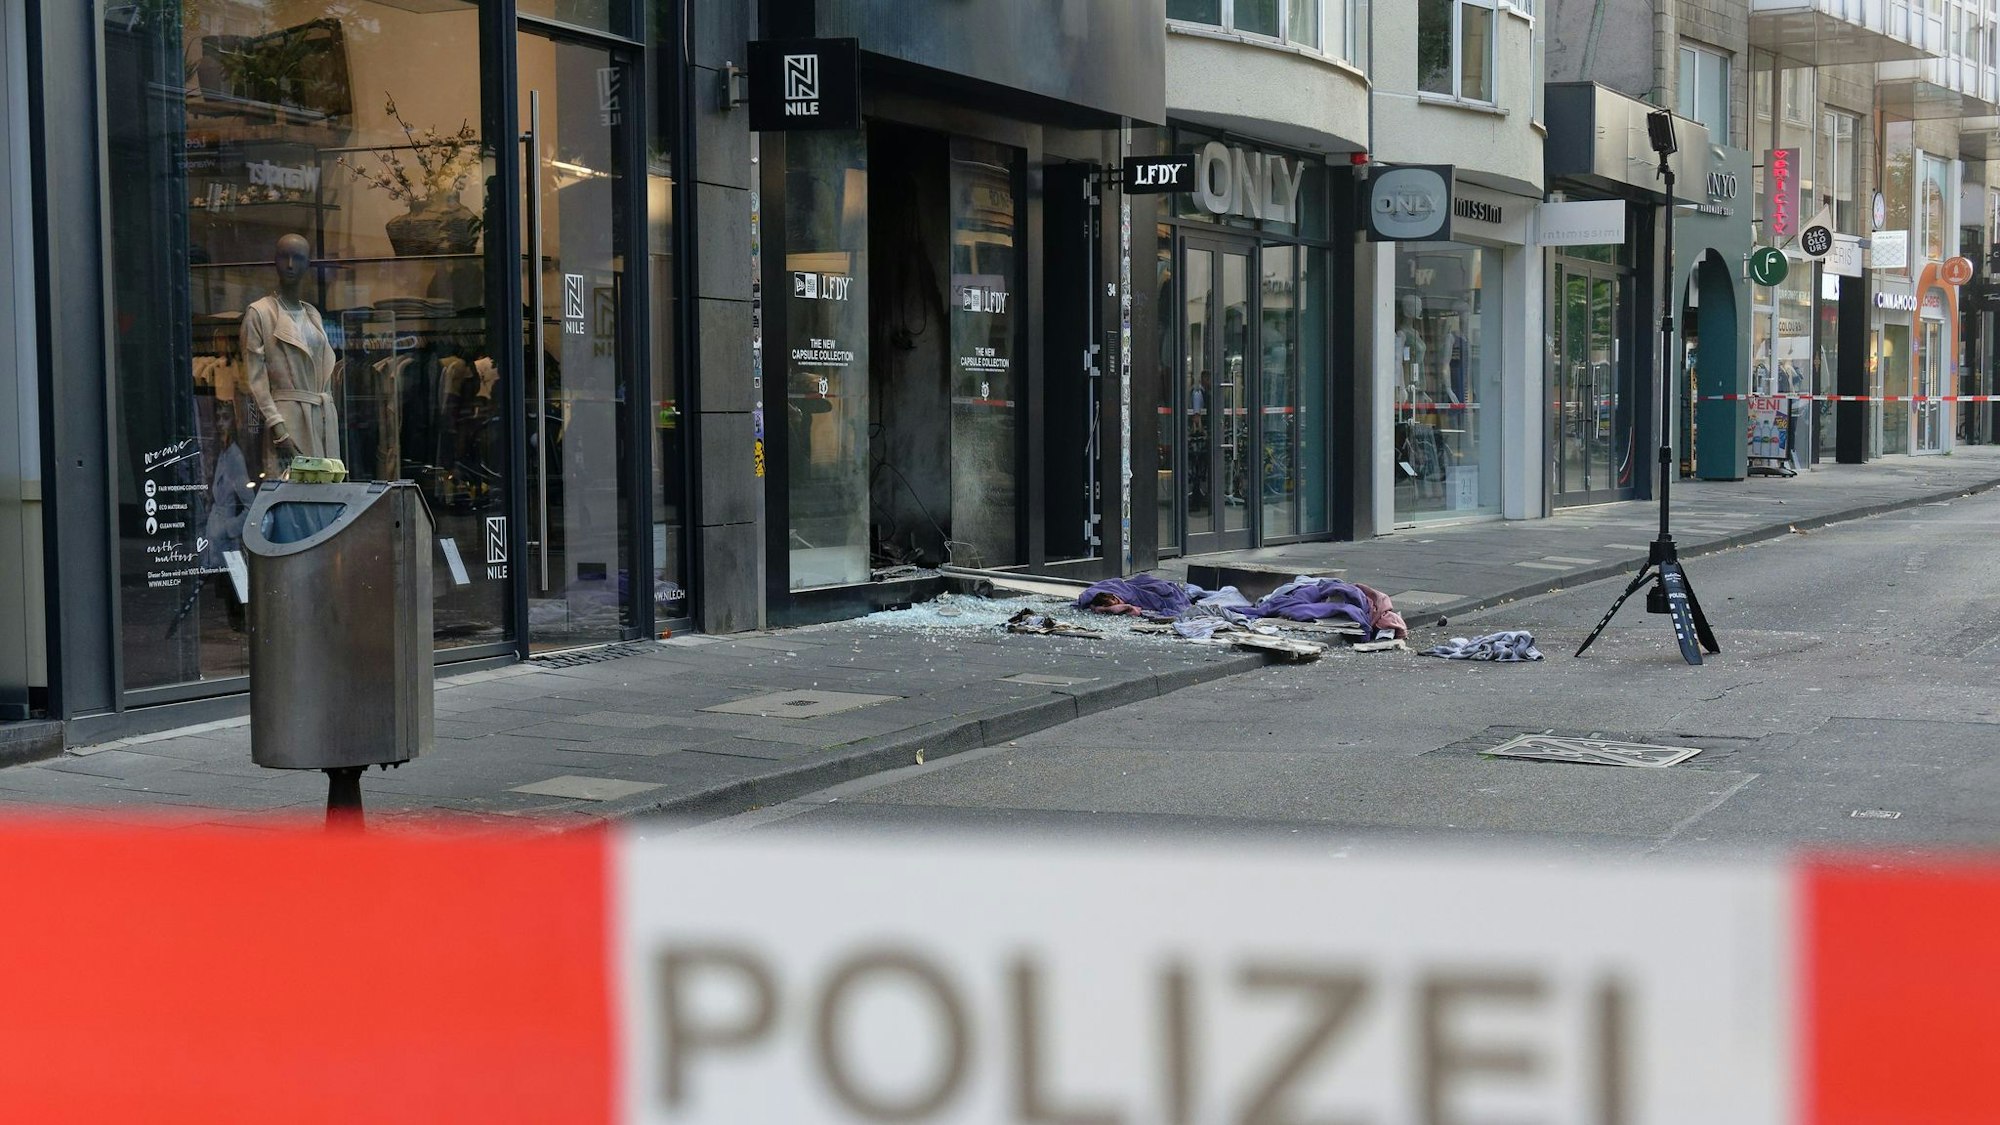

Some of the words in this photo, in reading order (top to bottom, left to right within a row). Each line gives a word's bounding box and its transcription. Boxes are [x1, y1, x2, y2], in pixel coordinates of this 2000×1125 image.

[785, 102, 819, 116] NILE
[1193, 141, 1305, 224] ONLY
[1375, 192, 1440, 215] ONLY
[1543, 229, 1620, 240] intimissimi
[1807, 237, 1827, 246] OLO
[1808, 244, 1828, 253] URS
[1107, 283, 1117, 297] 34
[1877, 291, 1917, 311] CINNAMOOD
[565, 322, 584, 334] NILE
[810, 338, 822, 349] THE
[823, 339, 836, 349] NEW
[791, 348, 819, 360] CAPSULE
[819, 351, 854, 361] COLLECTION
[975, 347, 985, 356] THE
[985, 348, 995, 357] NEW
[960, 357, 981, 366] CAPSULE
[982, 358, 1010, 368] COLLECTION
[1748, 399, 1780, 411] VENI
[487, 565, 508, 580] NILE
[648, 935, 1642, 1125] POLIZEI
